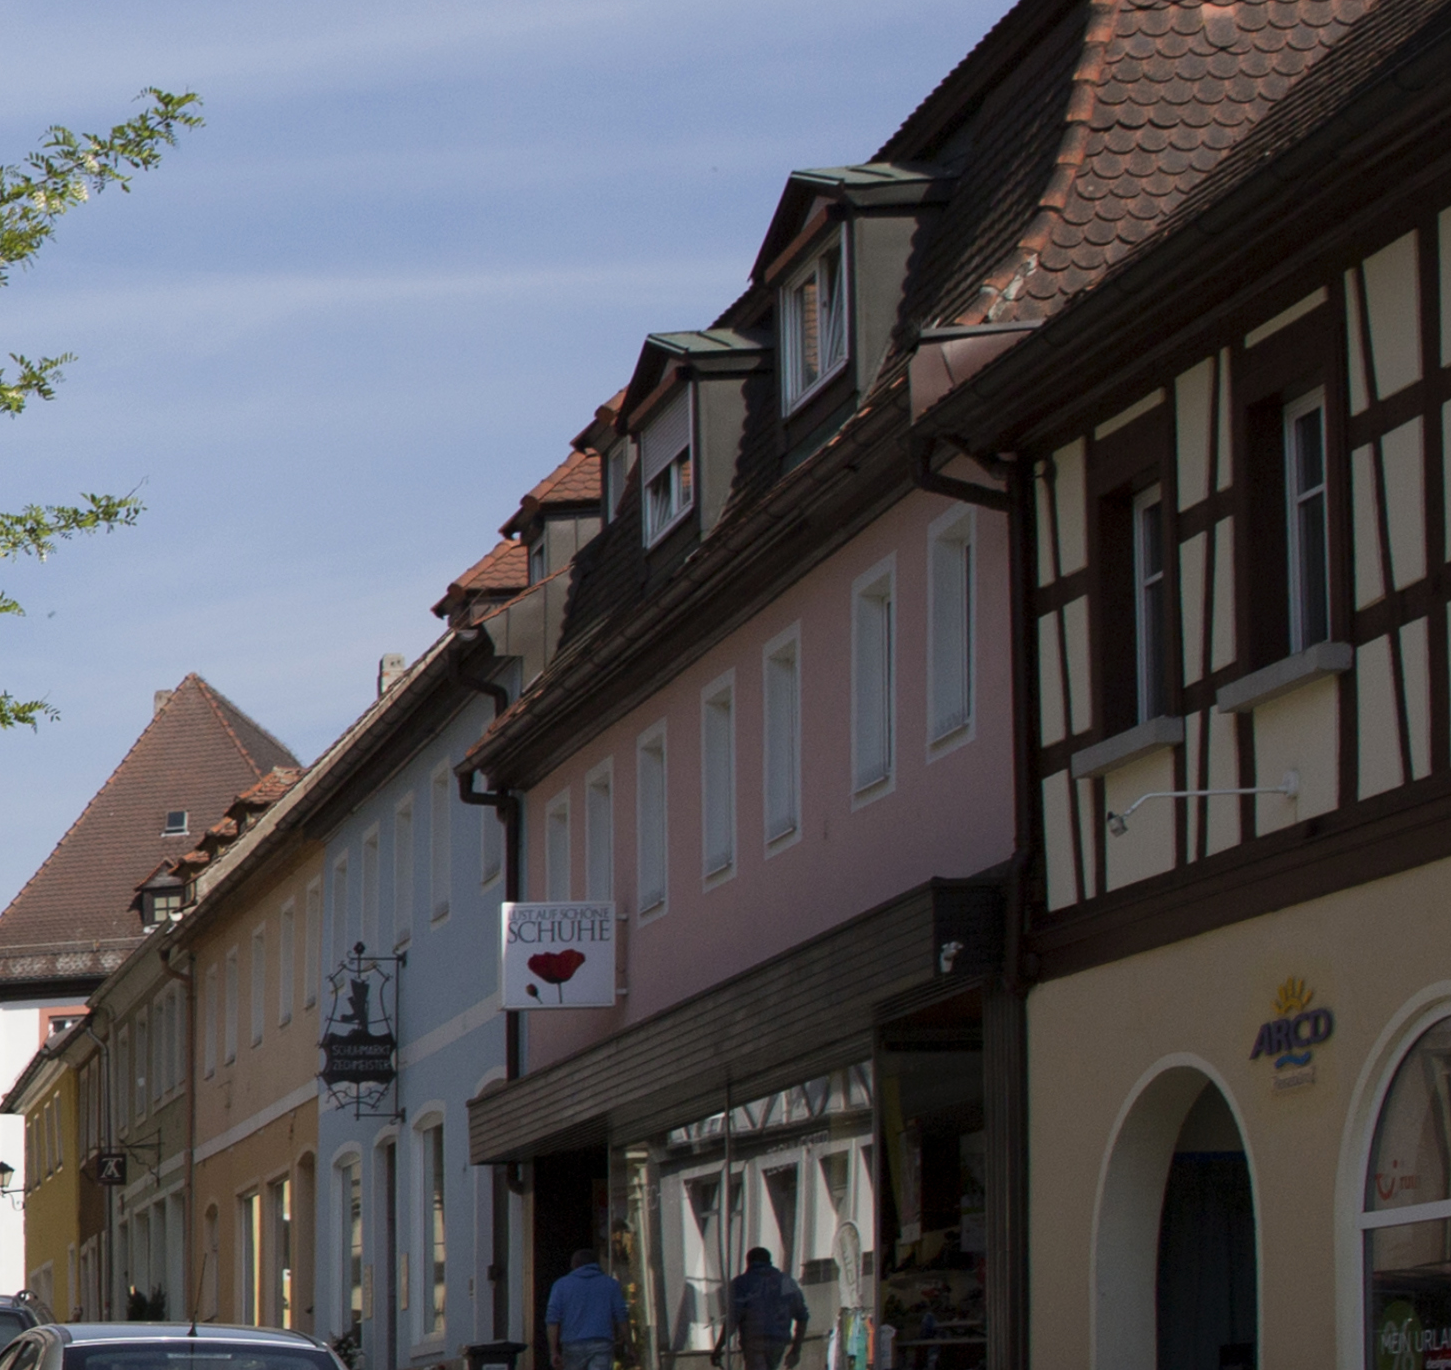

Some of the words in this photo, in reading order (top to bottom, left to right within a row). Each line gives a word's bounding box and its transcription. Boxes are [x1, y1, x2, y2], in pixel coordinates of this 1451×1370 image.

[535, 909, 557, 920] AUF
[560, 907, 610, 920] SCHÖNE
[507, 919, 611, 944] SCHUHE
[1249, 1009, 1334, 1060] ARCD
[332, 1044, 391, 1056] SCHUHMARKT
[1415, 1328, 1451, 1352] URLA
